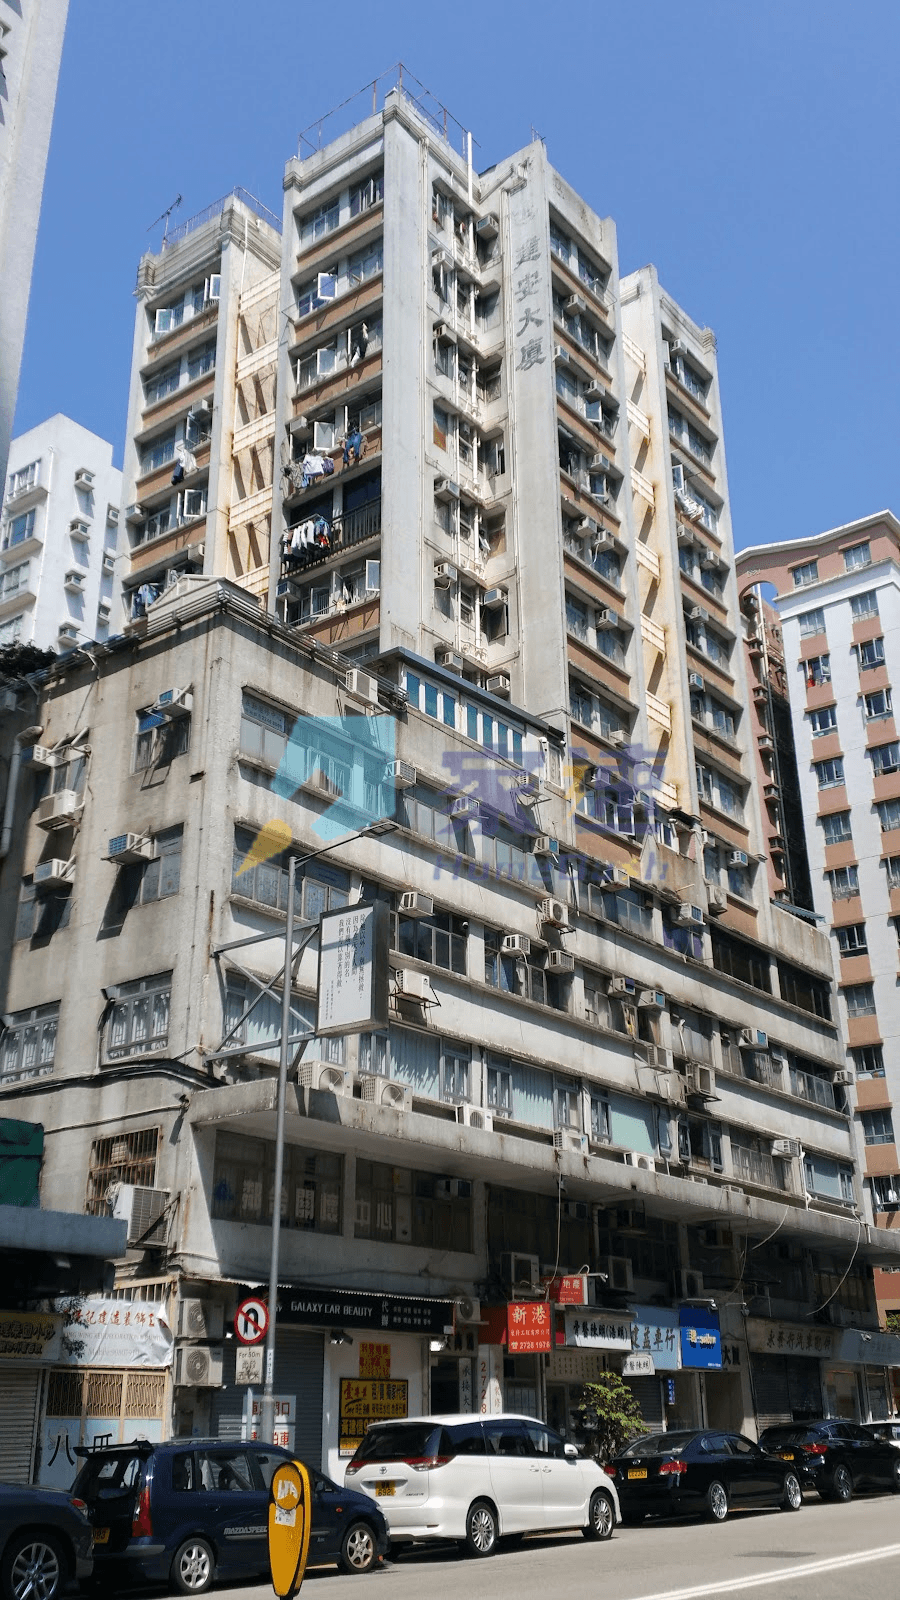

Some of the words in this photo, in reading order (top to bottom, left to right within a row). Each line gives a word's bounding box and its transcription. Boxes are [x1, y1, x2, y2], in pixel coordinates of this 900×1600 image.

[291, 1301, 323, 1312] GALAXY
[324, 1304, 340, 1315] CAR
[343, 1305, 373, 1317] BEAUTY
[512, 1305, 547, 1325] 新港
[519, 1341, 534, 1350] 2728
[462, 1366, 472, 1414] 承接大
